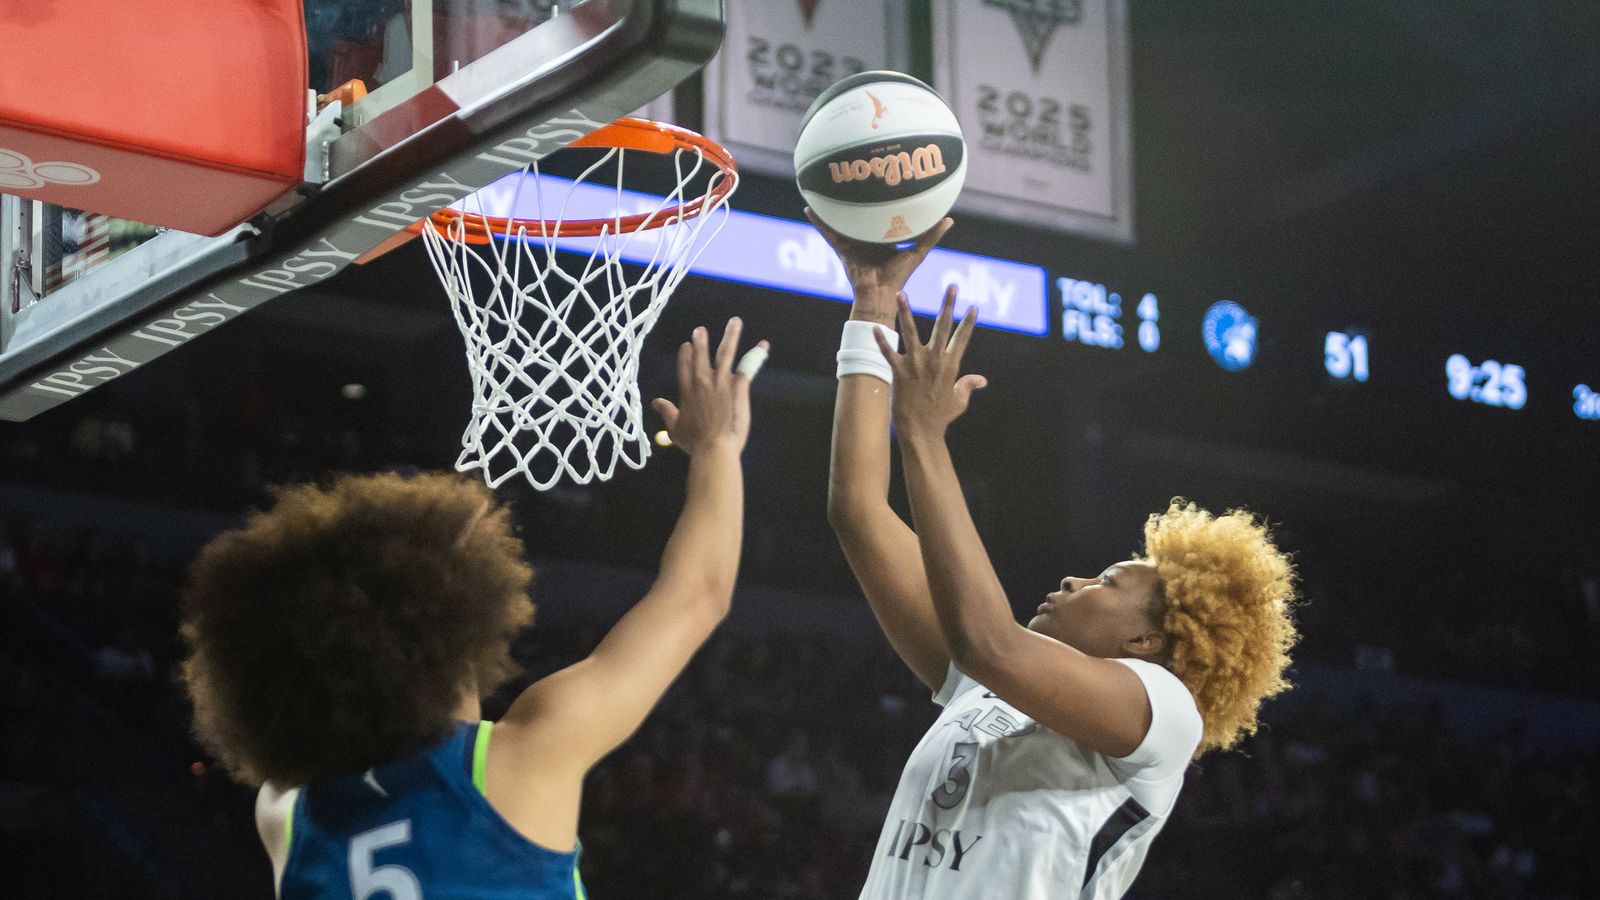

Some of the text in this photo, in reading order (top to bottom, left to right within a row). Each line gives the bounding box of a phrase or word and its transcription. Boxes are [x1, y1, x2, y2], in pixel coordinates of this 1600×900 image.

[977, 83, 1091, 130] 2025
[475, 109, 606, 168] IPSY
[829, 144, 946, 186] Wilson
[353, 172, 478, 232] IPSY
[240, 237, 361, 292] IPSY
[131, 293, 248, 346] IPSY
[1057, 277, 1159, 322] TOL: 4
[30, 347, 142, 396] IPSY
[1324, 331, 1369, 381] 51
[1445, 353, 1527, 410] 9:25
[931, 742, 979, 809] 3
[348, 818, 424, 900] 5
[886, 819, 983, 871] IPSY
